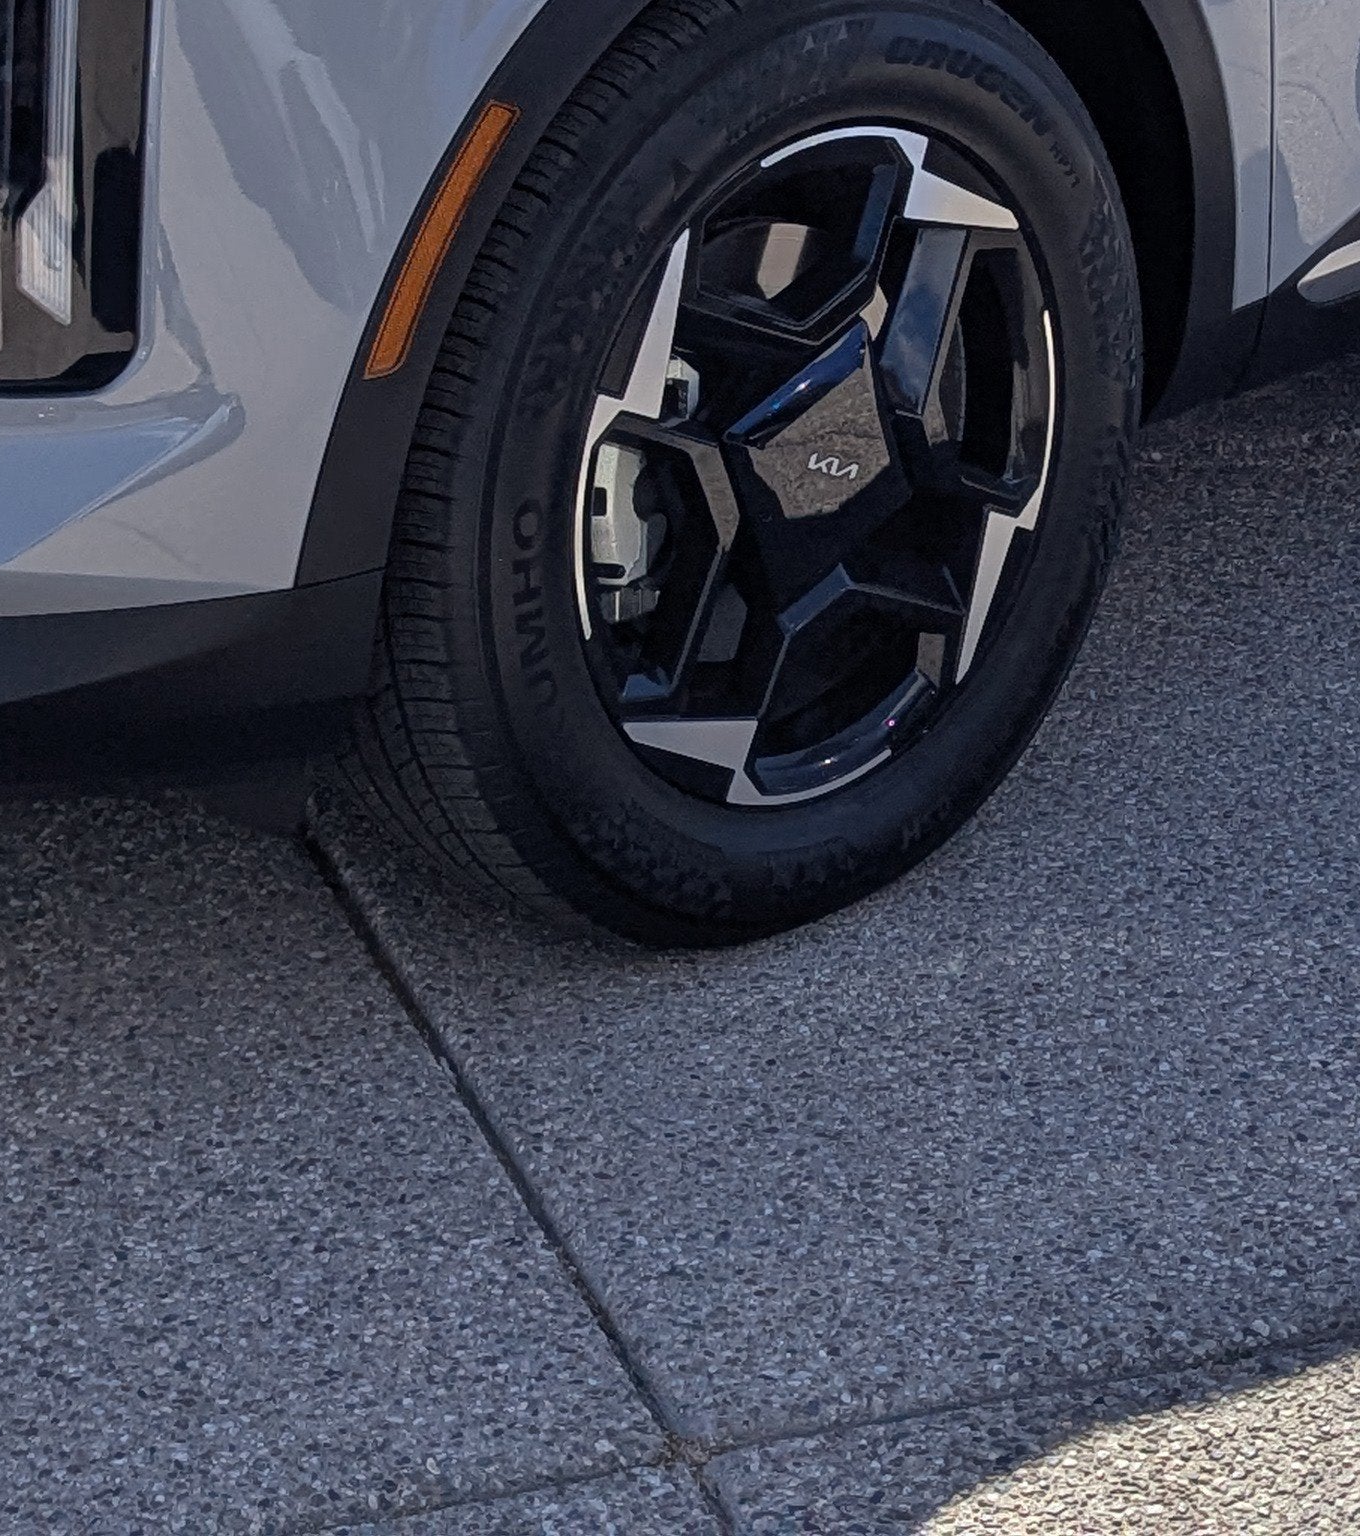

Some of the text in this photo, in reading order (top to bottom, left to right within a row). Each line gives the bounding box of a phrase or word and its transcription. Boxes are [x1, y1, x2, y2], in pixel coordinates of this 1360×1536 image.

[884, 35, 1057, 136] CRUGEN
[807, 452, 859, 480] KIA
[511, 497, 562, 728] UMHO
